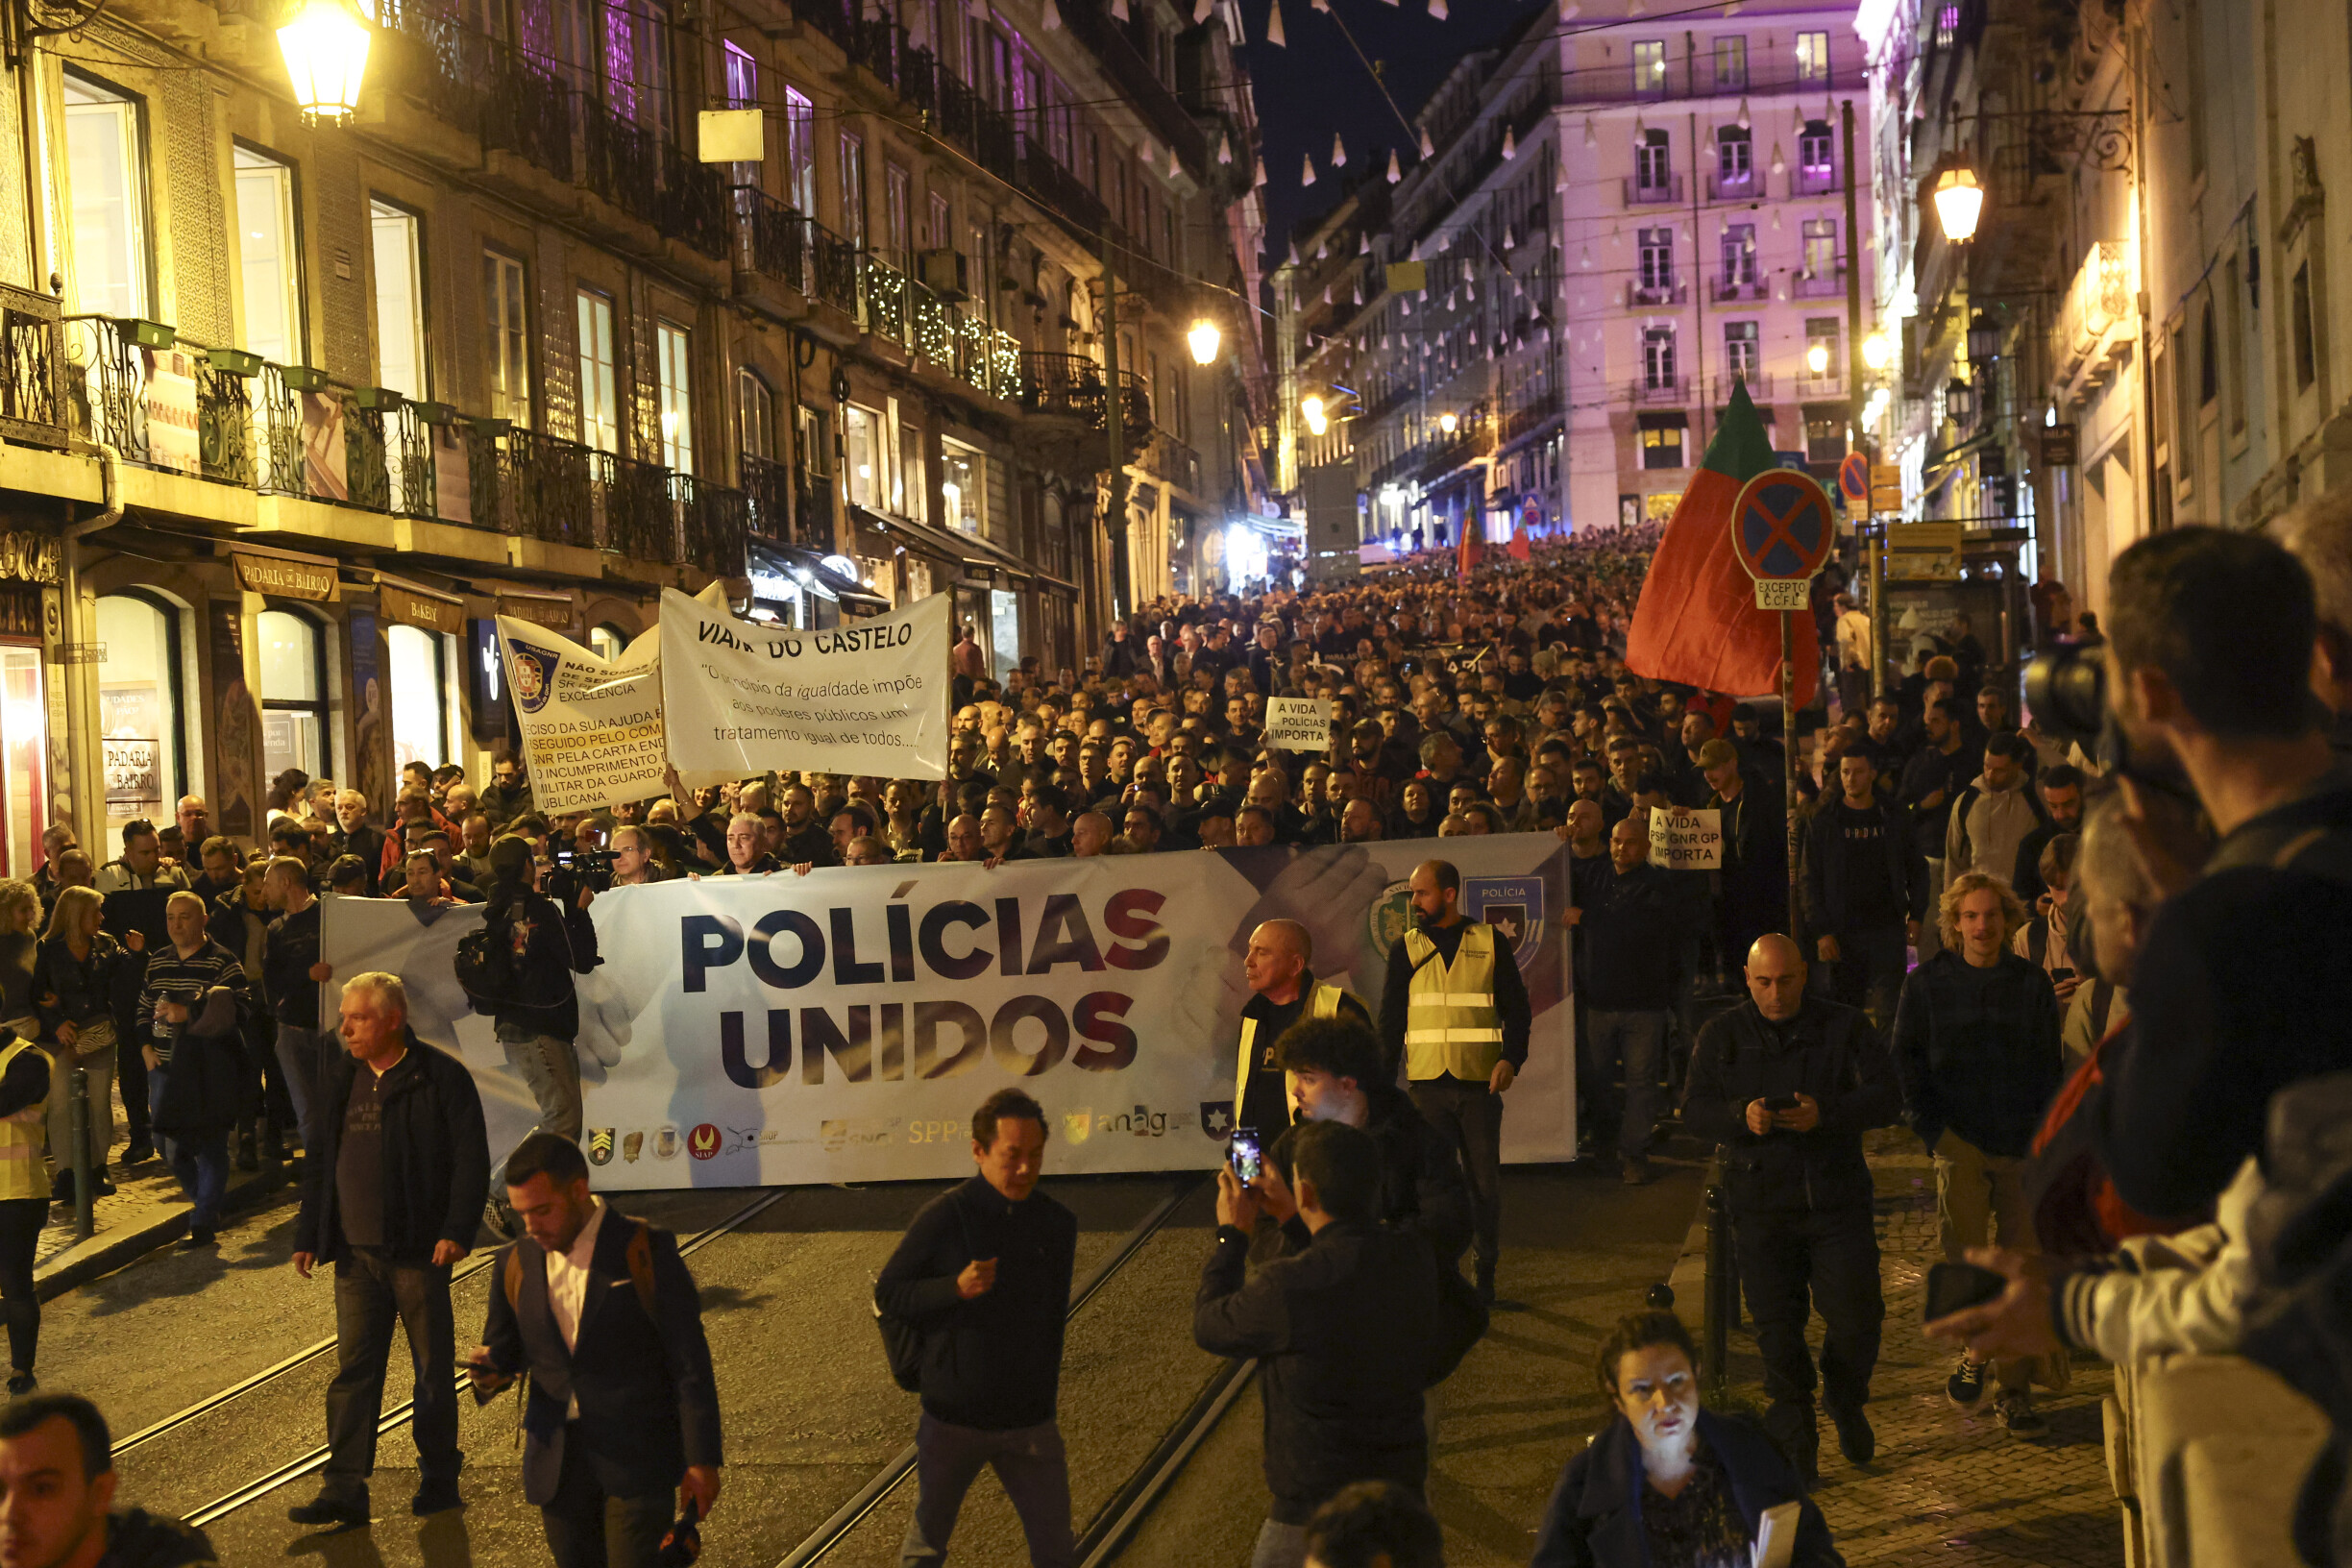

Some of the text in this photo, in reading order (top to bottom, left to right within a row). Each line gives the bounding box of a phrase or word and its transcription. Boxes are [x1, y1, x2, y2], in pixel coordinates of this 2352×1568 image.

[244, 565, 284, 586] PADARIA
[296, 573, 330, 592] BAIRRO
[1758, 581, 1805, 593] EXCEPTO
[769, 639, 802, 659] DO
[815, 623, 912, 654] CASTELO
[526, 645, 559, 659] USAGNR
[565, 661, 596, 674] NÃO
[774, 681, 792, 698] da
[796, 680, 870, 701] igualdade
[873, 674, 922, 695] impõe
[732, 698, 908, 723] aos poderes públicos um
[1278, 703, 1317, 715] A VIDA
[560, 723, 577, 733] DA
[580, 720, 607, 732] SUA
[608, 711, 653, 728] AJUDA
[1282, 716, 1326, 728] POLÍCIAS
[589, 730, 625, 746] PELO
[714, 726, 800, 741] tratamento
[804, 732, 838, 746] igual
[841, 732, 860, 743] de
[1271, 729, 1324, 742] IMPORTA
[108, 750, 154, 767] PADARIA
[557, 749, 591, 764] PELA
[592, 743, 637, 760] CARTA
[546, 753, 657, 779] INCUMPRIMENTO
[116, 773, 154, 790] BAIRRO
[587, 776, 606, 790] DA
[608, 767, 666, 785] GUARDA
[1656, 816, 1701, 828] A VIDA
[1651, 830, 1719, 845] PSP GNR GP
[1654, 846, 1714, 862] IMPORTA
[1482, 887, 1526, 898] POLÍCIA
[681, 880, 1171, 993] POLÍCIAS
[720, 991, 1139, 1090] UNIDOS
